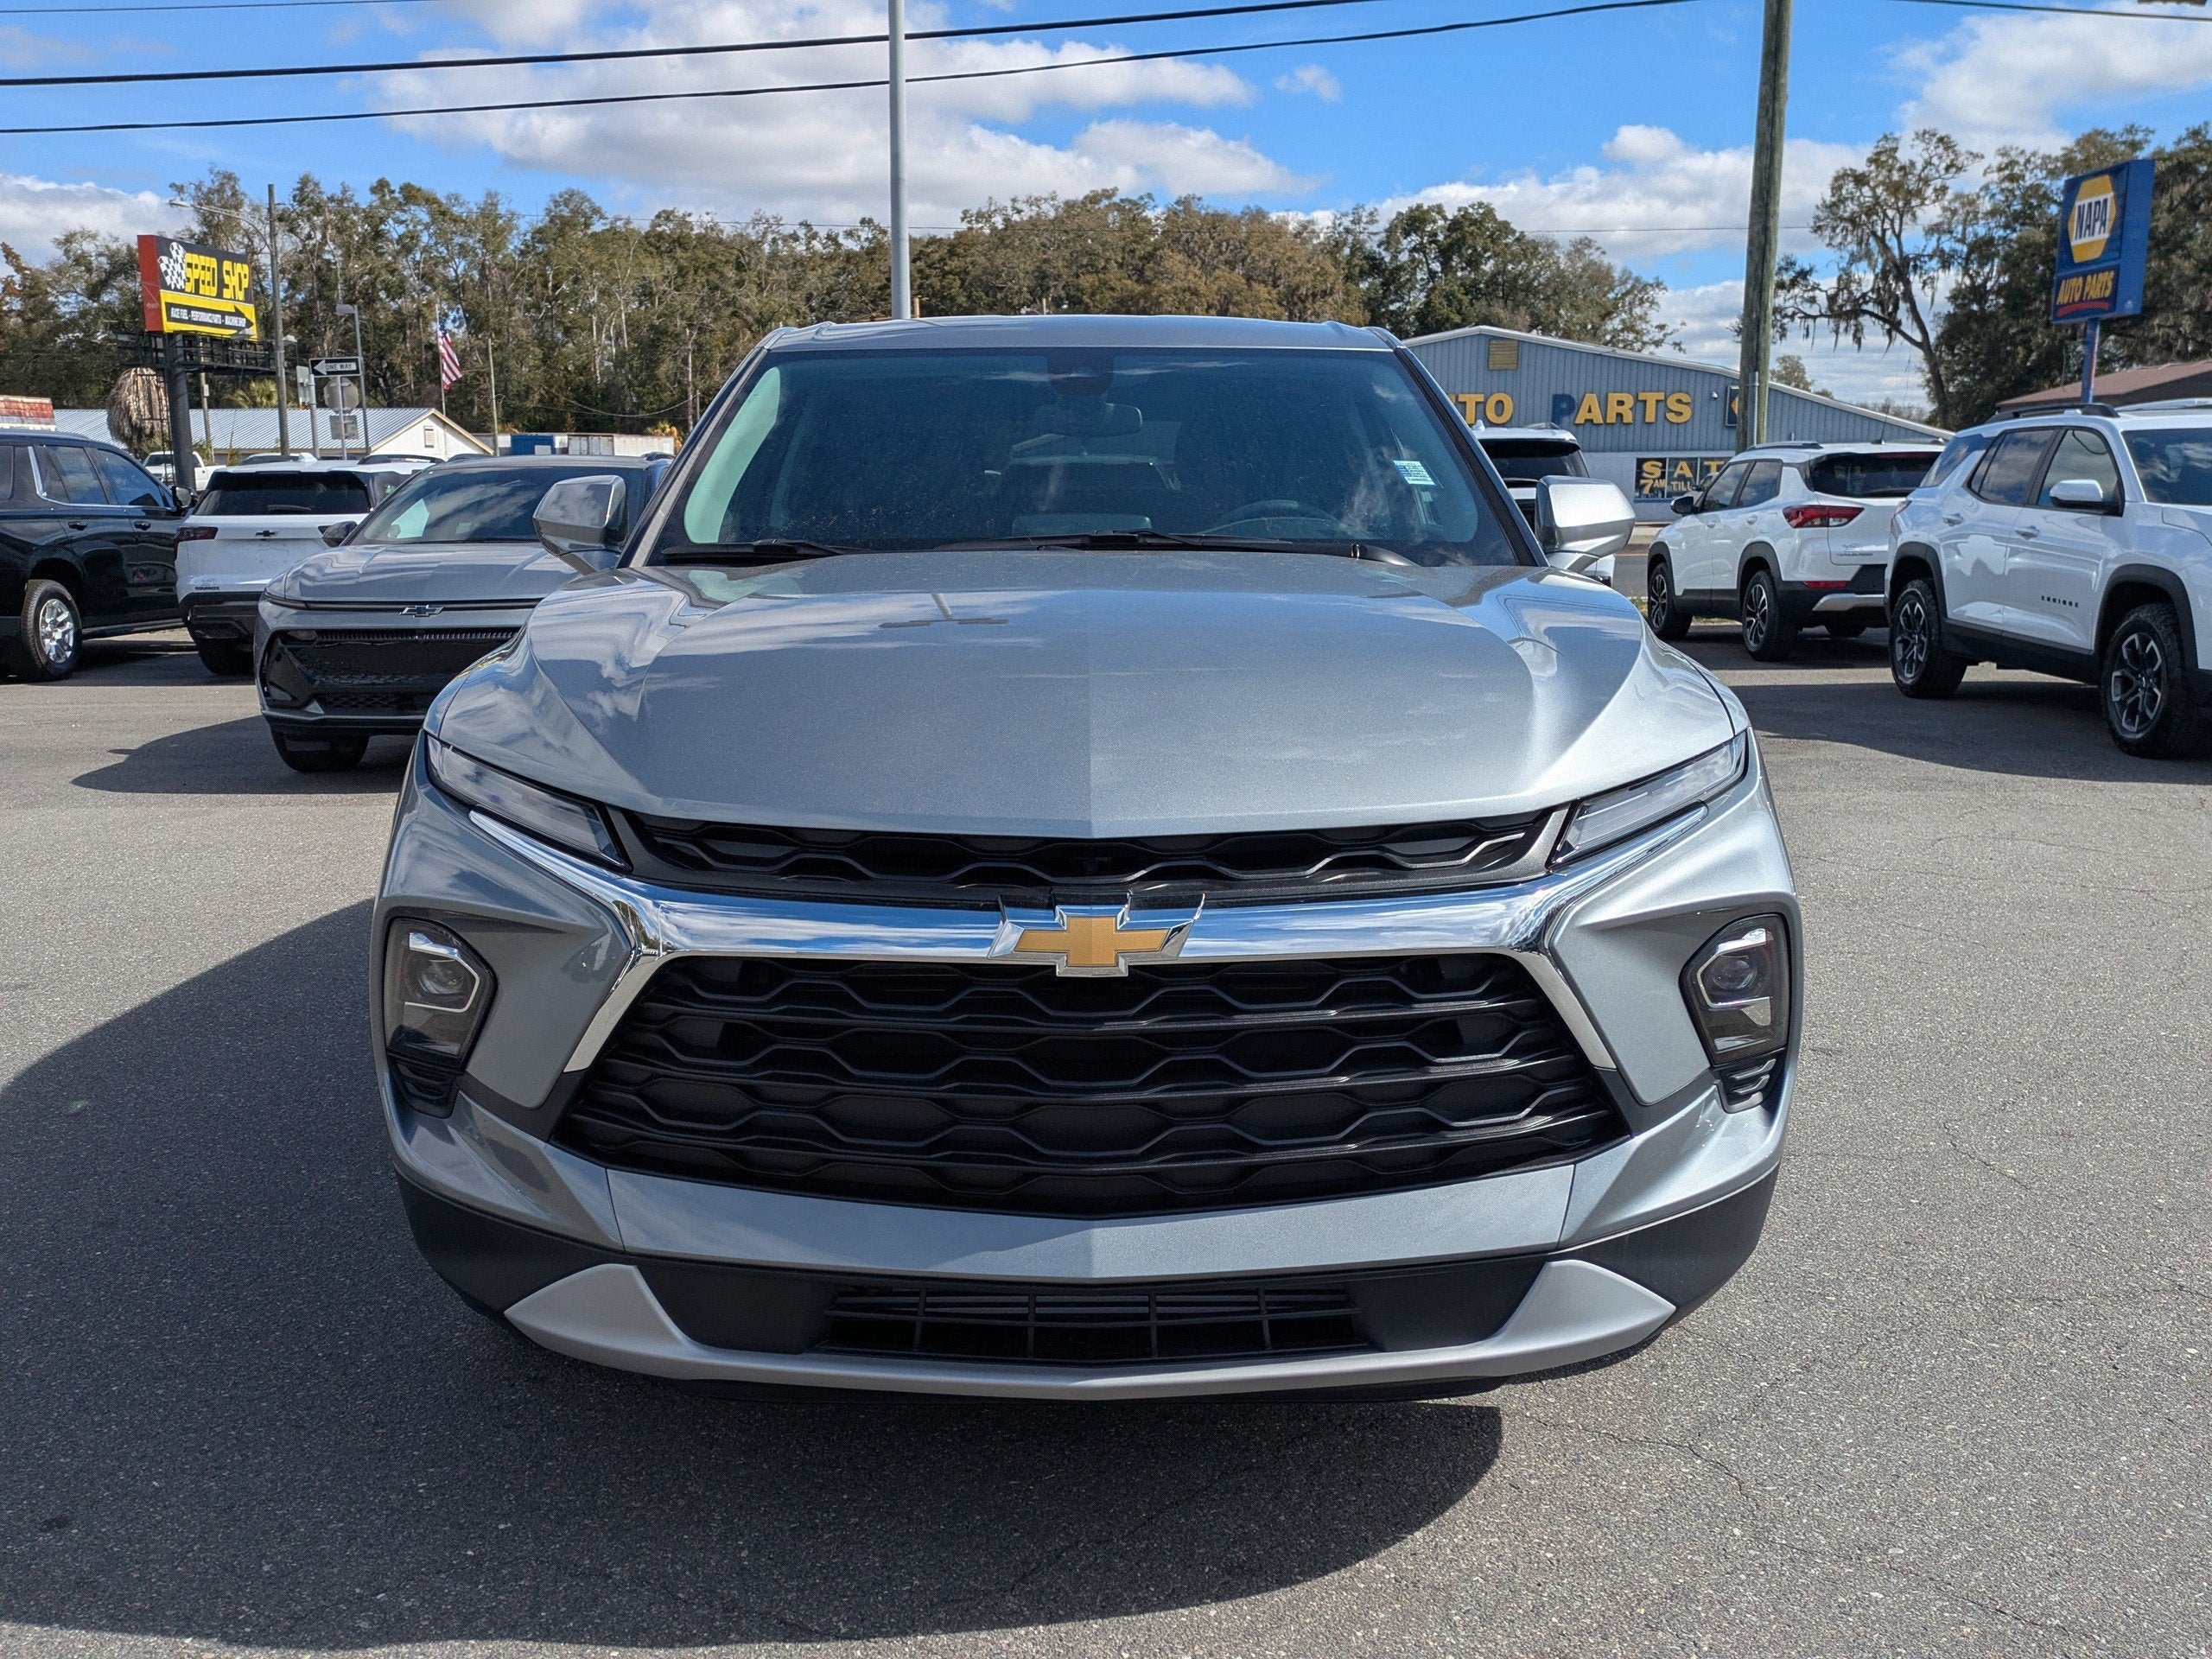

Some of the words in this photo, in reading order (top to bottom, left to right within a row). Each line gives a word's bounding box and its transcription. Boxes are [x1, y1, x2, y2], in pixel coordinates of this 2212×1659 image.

[2075, 198, 2108, 240] NAPA
[185, 252, 217, 296] SPEED
[223, 260, 249, 301] SHOP
[2056, 276, 2083, 305] AUTO
[2083, 270, 2114, 301] PARTS
[1552, 391, 1692, 425] PARTS
